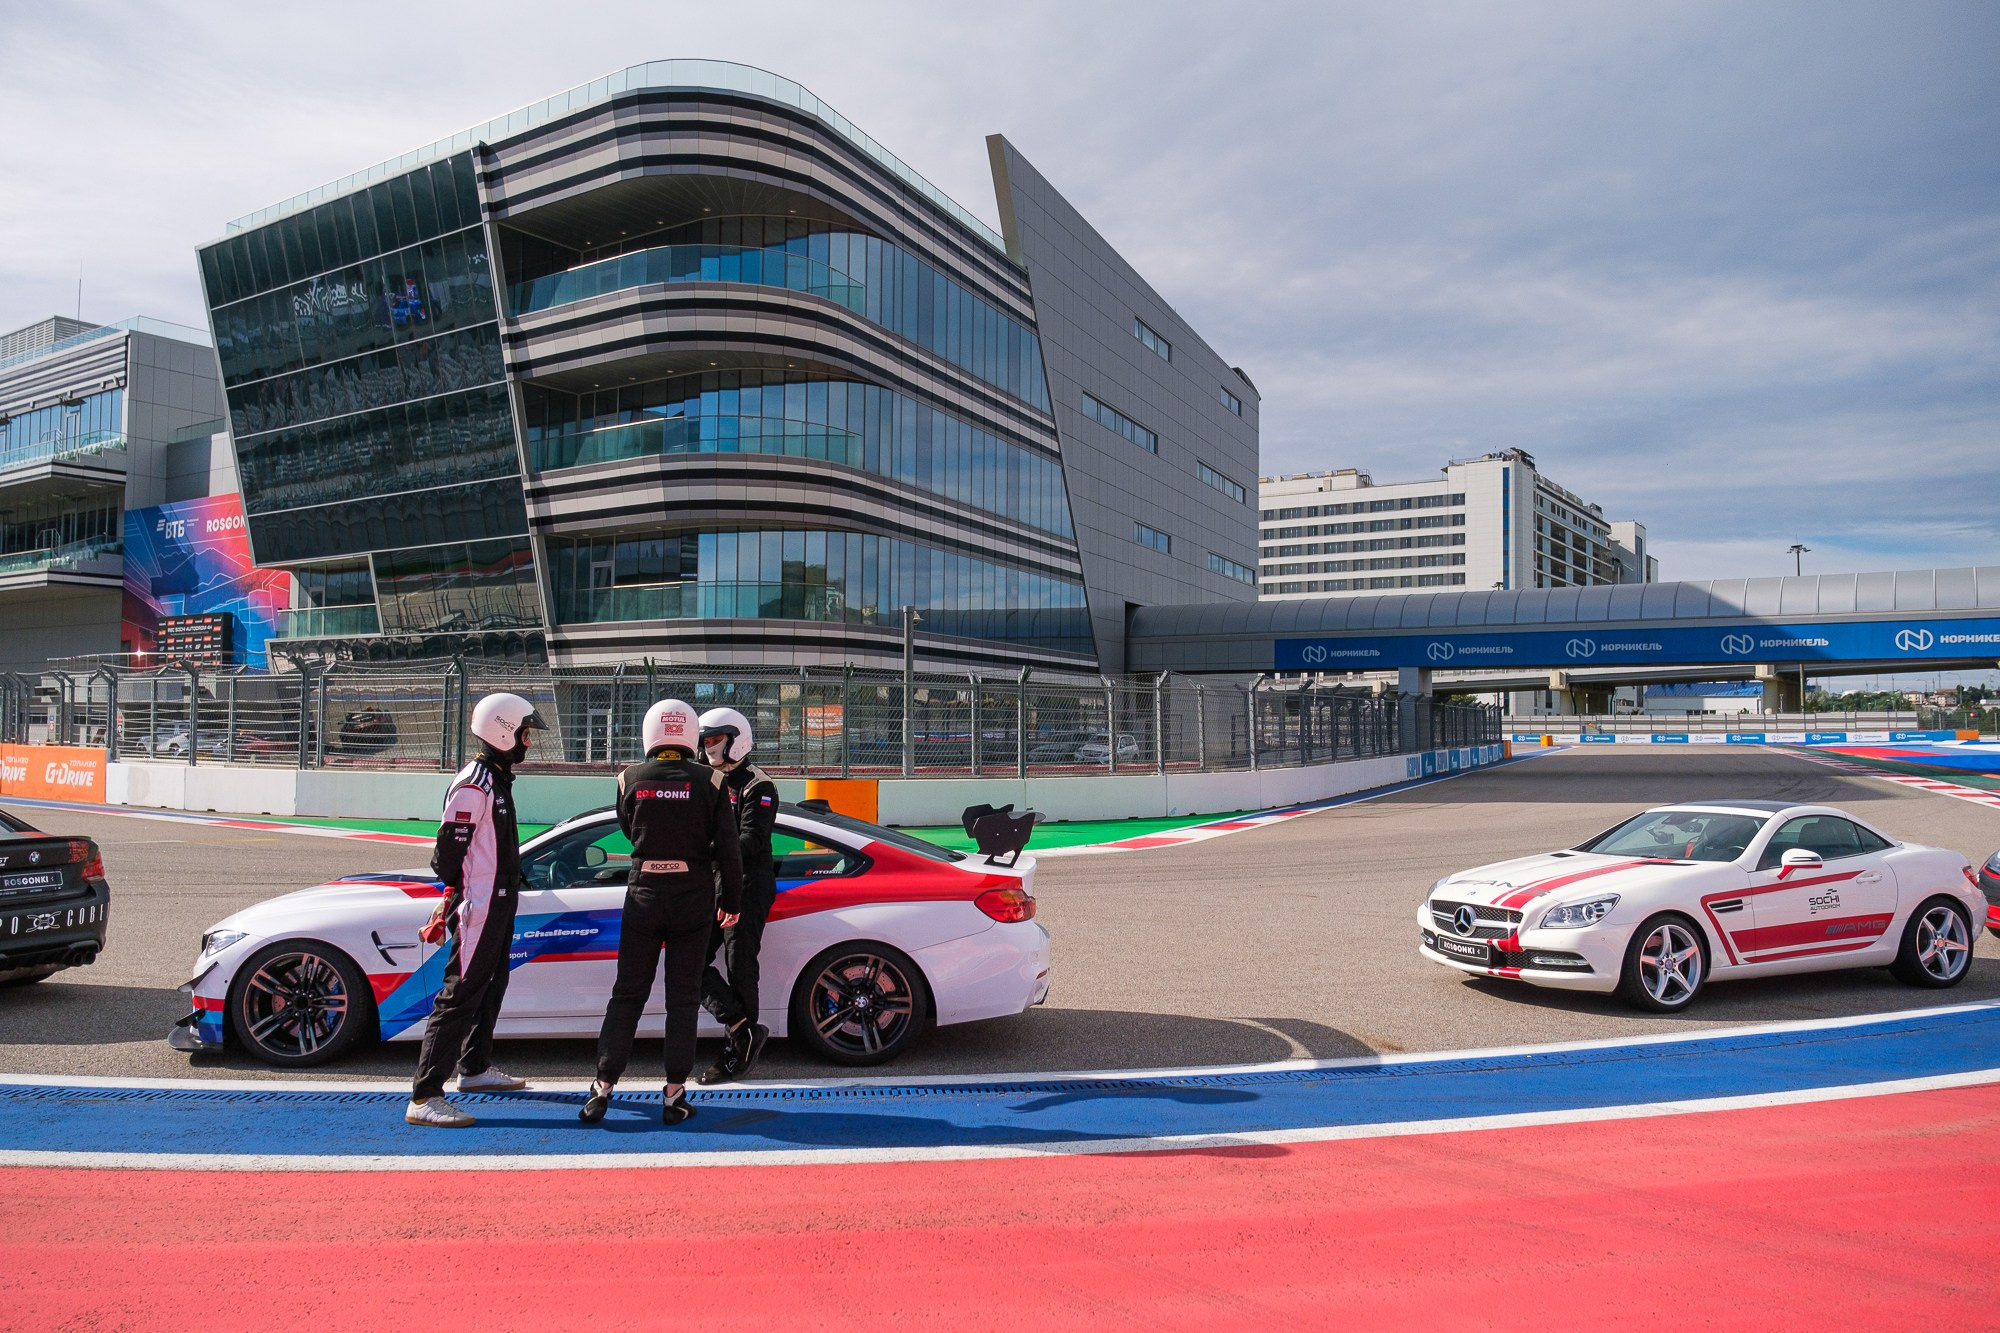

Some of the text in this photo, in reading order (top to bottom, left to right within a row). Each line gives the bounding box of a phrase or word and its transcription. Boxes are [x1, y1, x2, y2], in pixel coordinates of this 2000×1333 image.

[165, 520, 184, 539] ВТБ
[1601, 643, 1662, 652] НОРНИКЕЛЬ
[1760, 637, 1829, 648] НОРНИКЕЛЬ
[1331, 649, 1380, 658] НОРНИКЕЛЬ
[1459, 646, 1514, 655] НОРНИКЕЛЬ
[636, 789, 690, 799] ROSGONKI
[4, 876, 49, 887] ROSGONKI
[1808, 895, 1840, 906] SOCHI
[1843, 920, 1886, 932] AMG
[523, 927, 599, 938] Challenge
